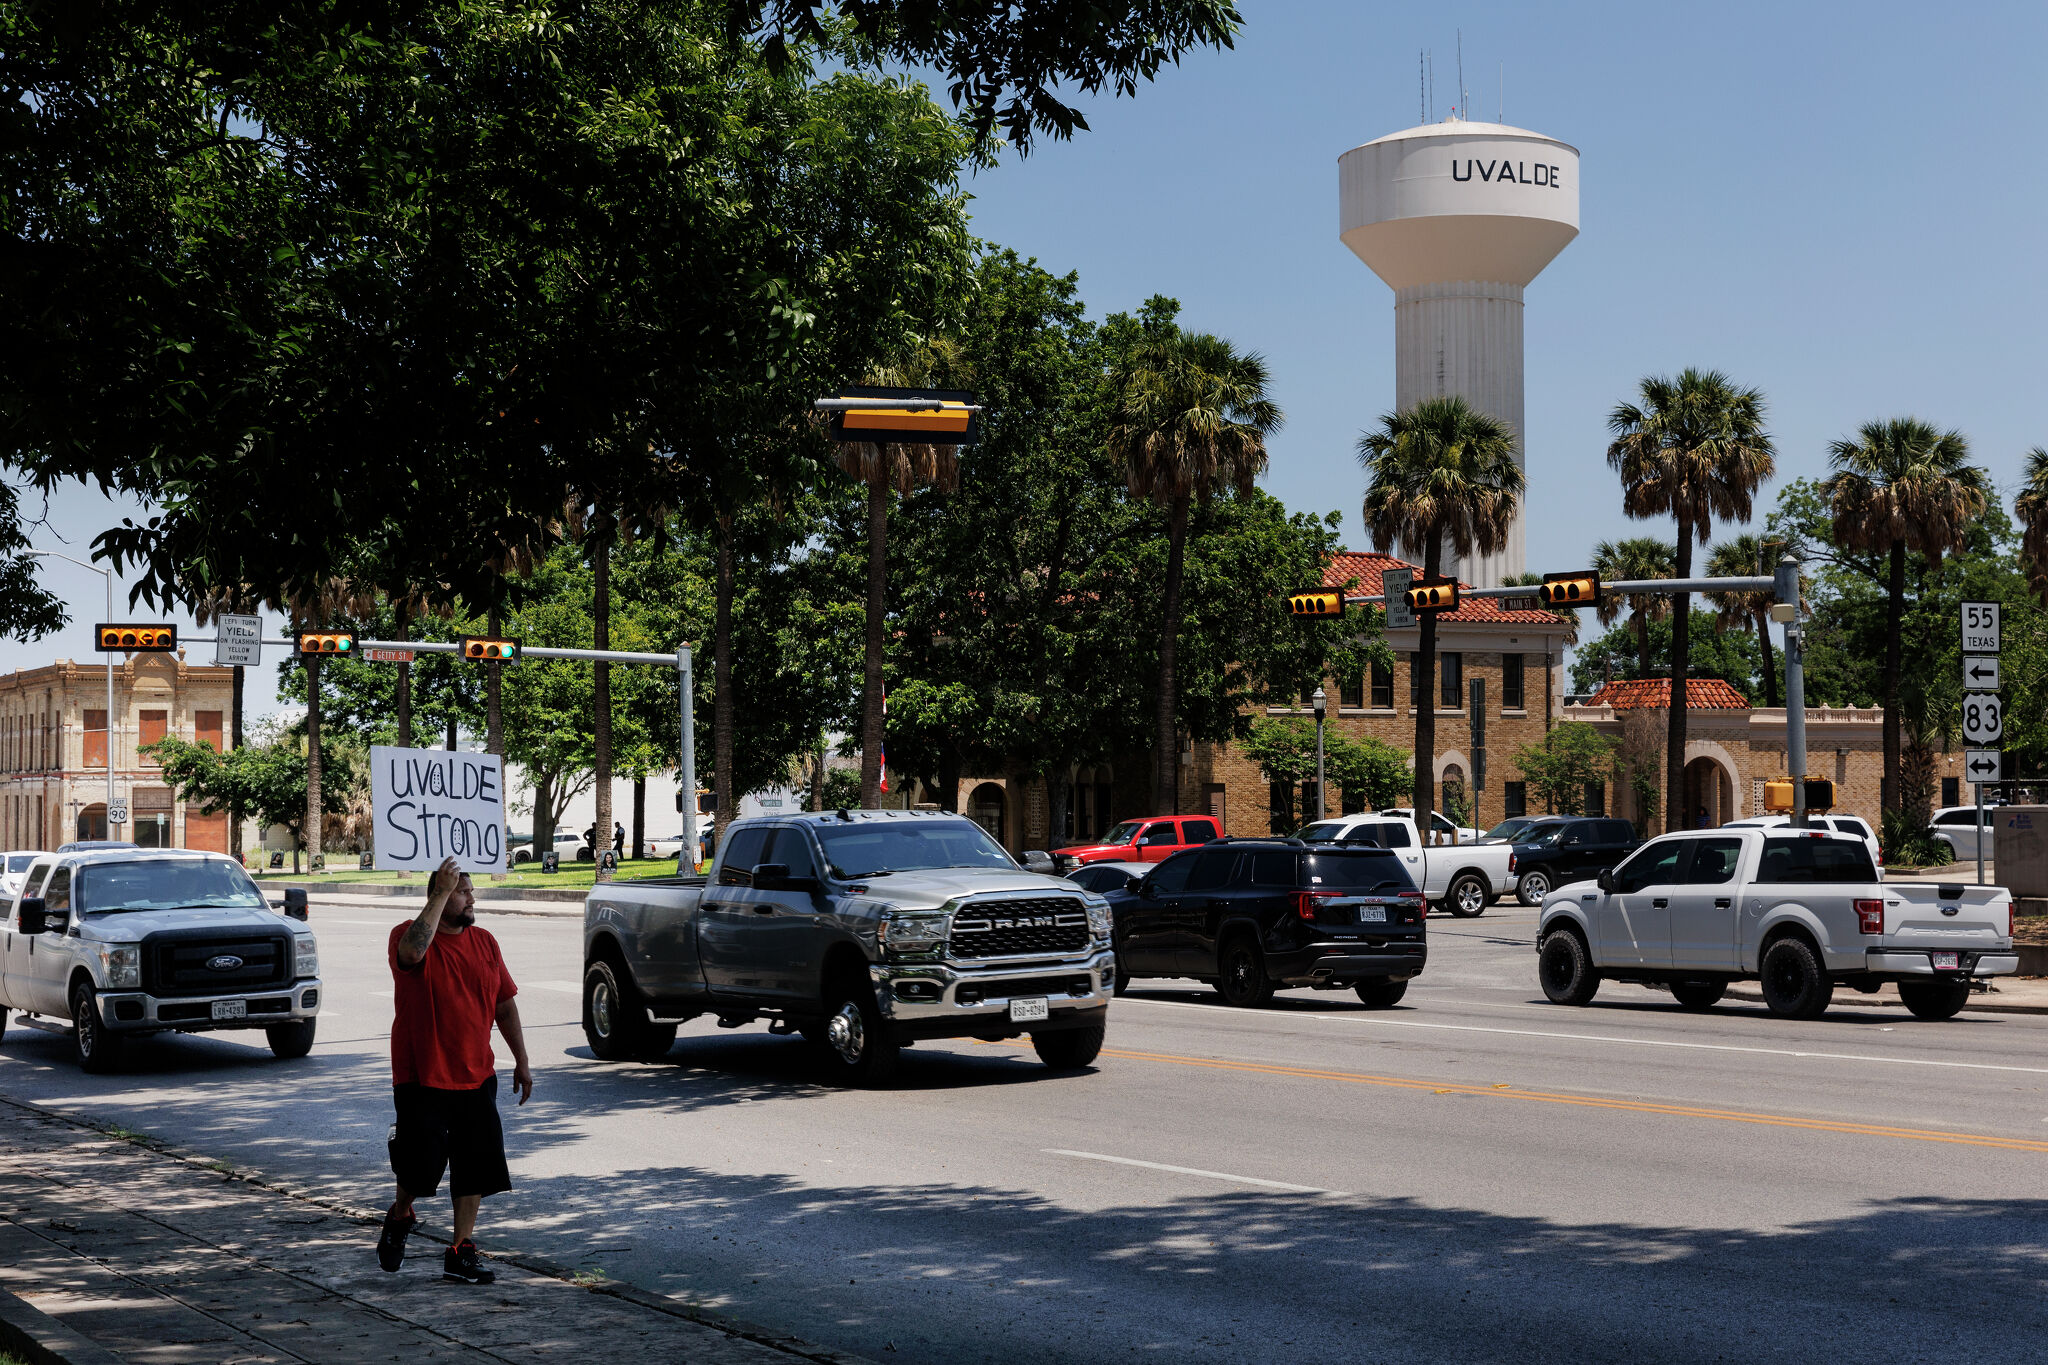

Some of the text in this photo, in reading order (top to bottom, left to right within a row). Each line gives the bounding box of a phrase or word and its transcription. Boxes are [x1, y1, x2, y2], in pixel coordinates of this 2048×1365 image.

[1452, 159, 1560, 189] UVALDE
[1509, 599, 1523, 609] MAIN
[1968, 607, 1994, 629] 55
[226, 627, 255, 637] YIELD
[231, 638, 259, 646] FLASHING
[1967, 636, 1995, 648] TEXAS
[376, 650, 396, 660] GETTY
[1966, 703, 1999, 733] 83
[111, 810, 126, 820] 90
[386, 801, 500, 865] Strong
[995, 916, 1053, 929] RAM
[214, 958, 235, 968] Ford
